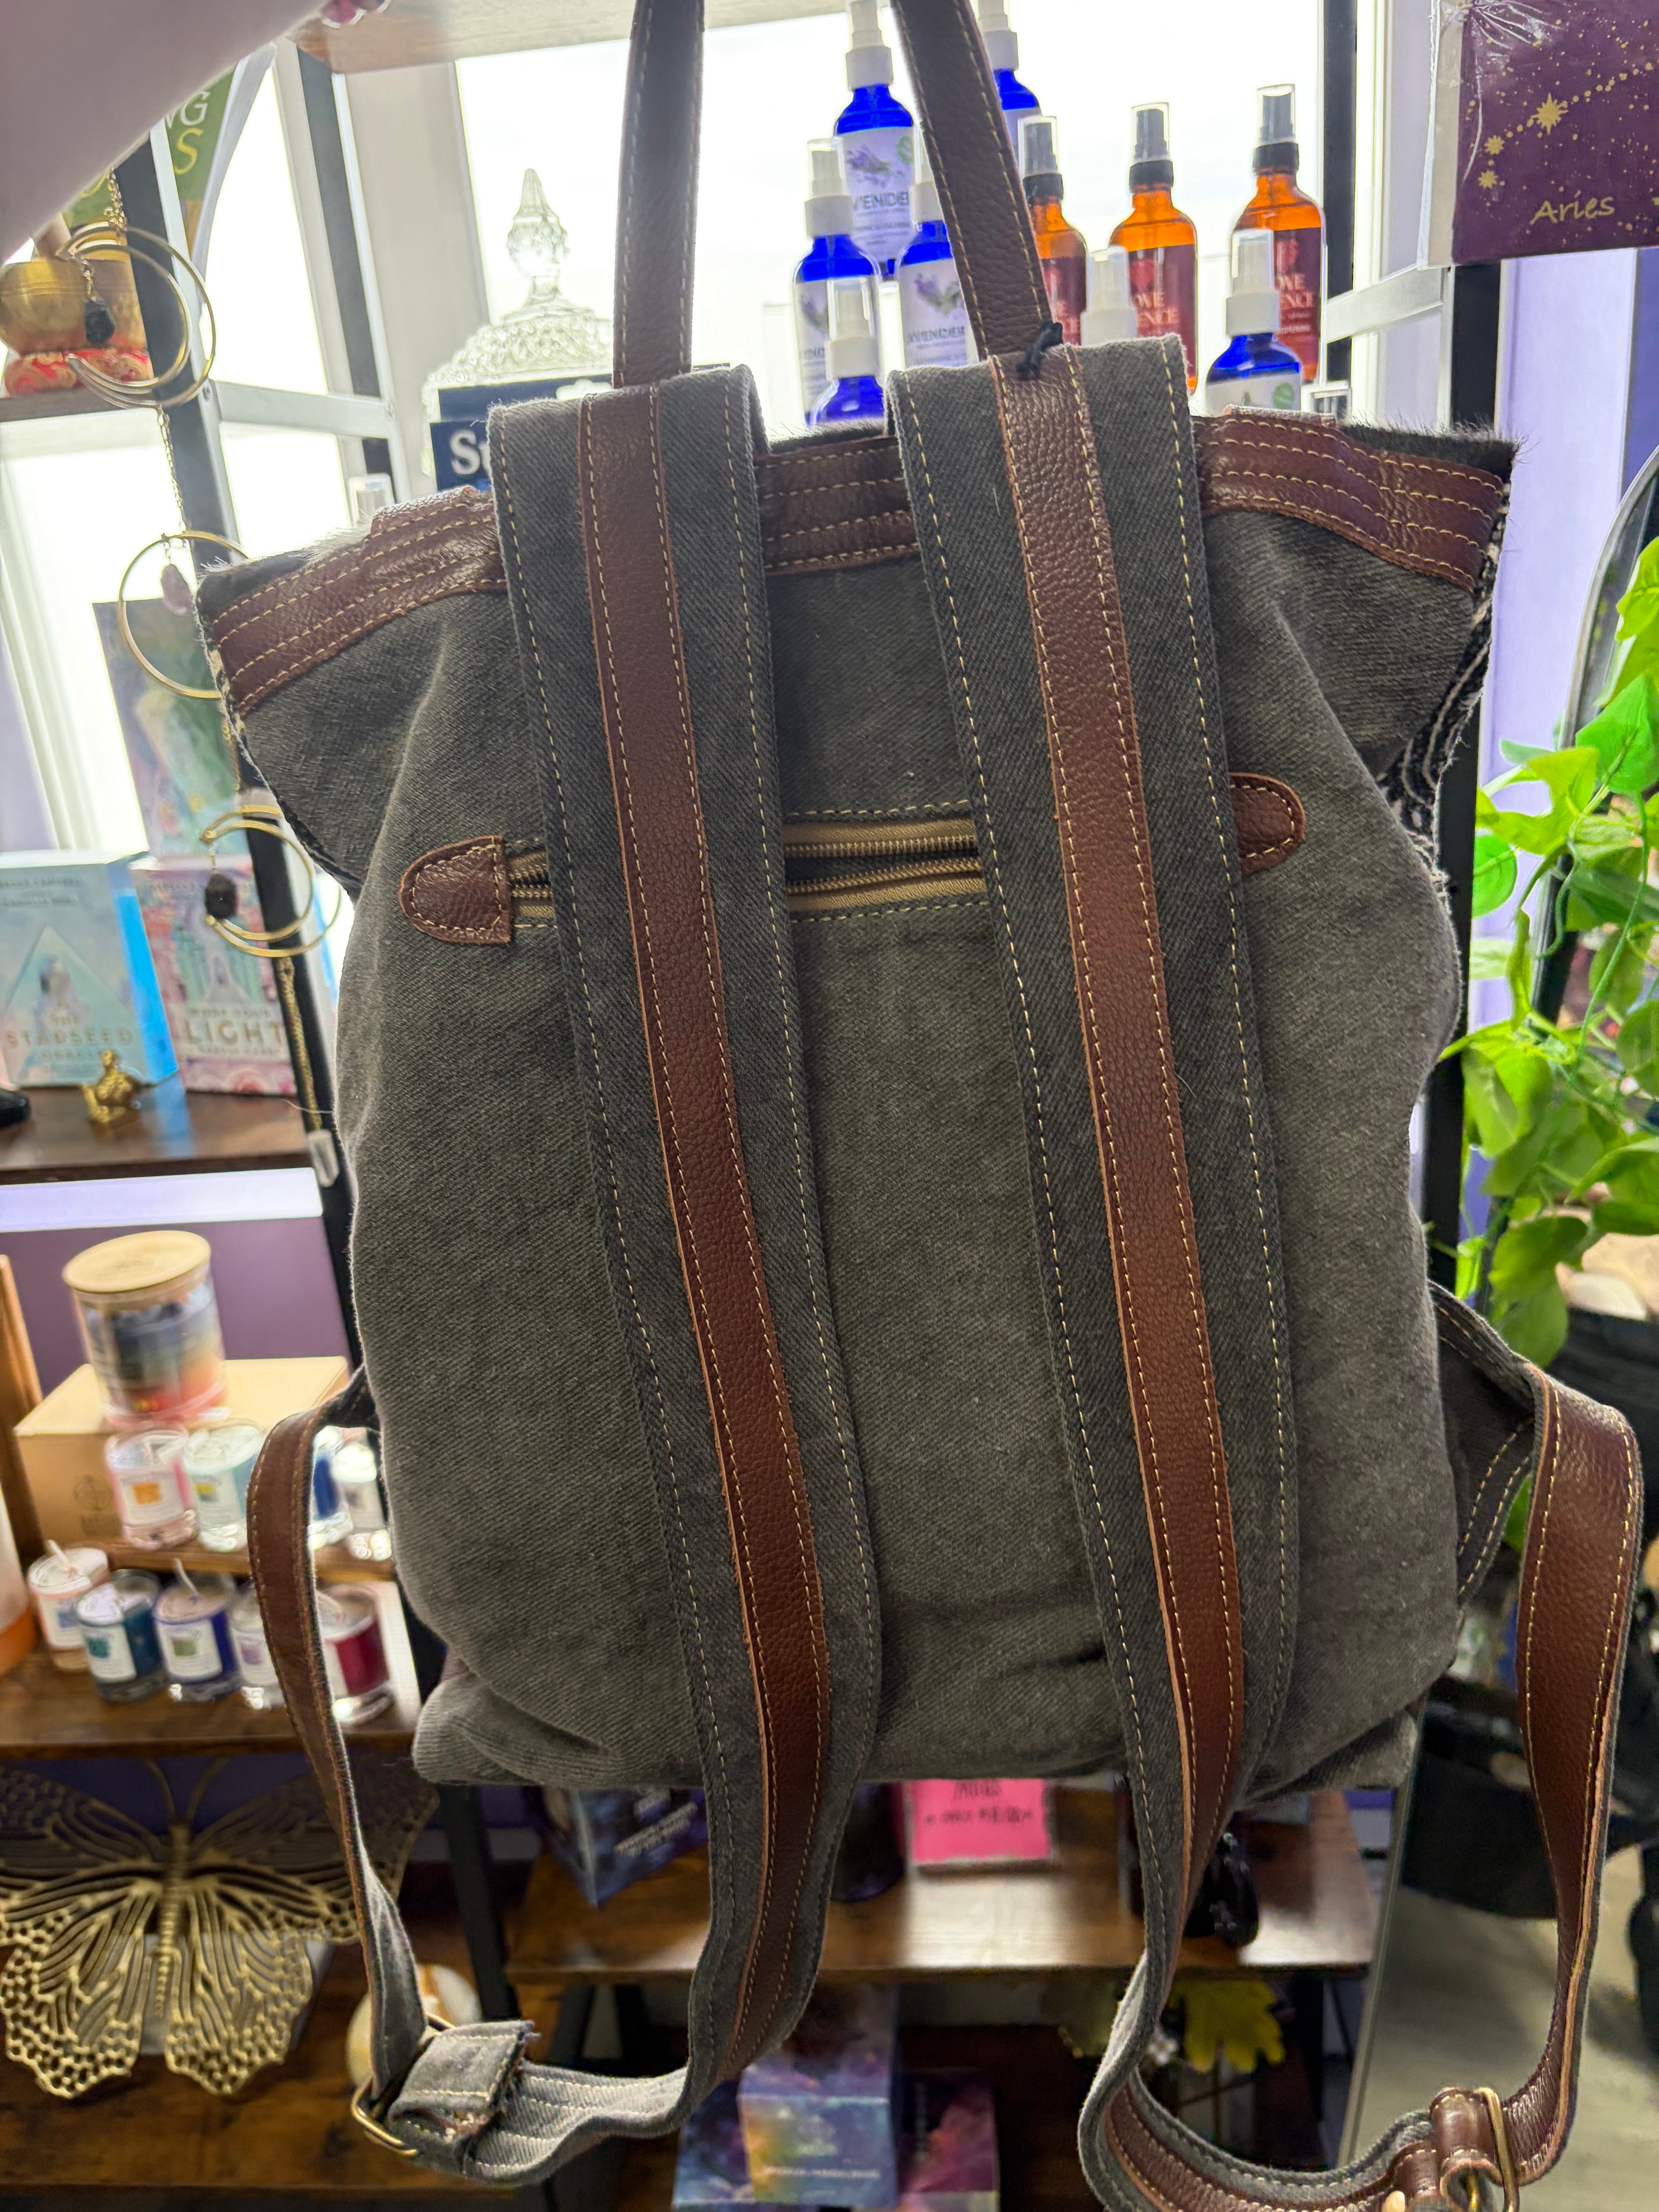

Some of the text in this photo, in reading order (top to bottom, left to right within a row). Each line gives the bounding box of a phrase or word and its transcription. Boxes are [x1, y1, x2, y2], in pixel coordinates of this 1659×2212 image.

[853, 191, 909, 210] VENDE
[1529, 190, 1615, 225] Aries
[185, 1018, 282, 1046] LIGHT
